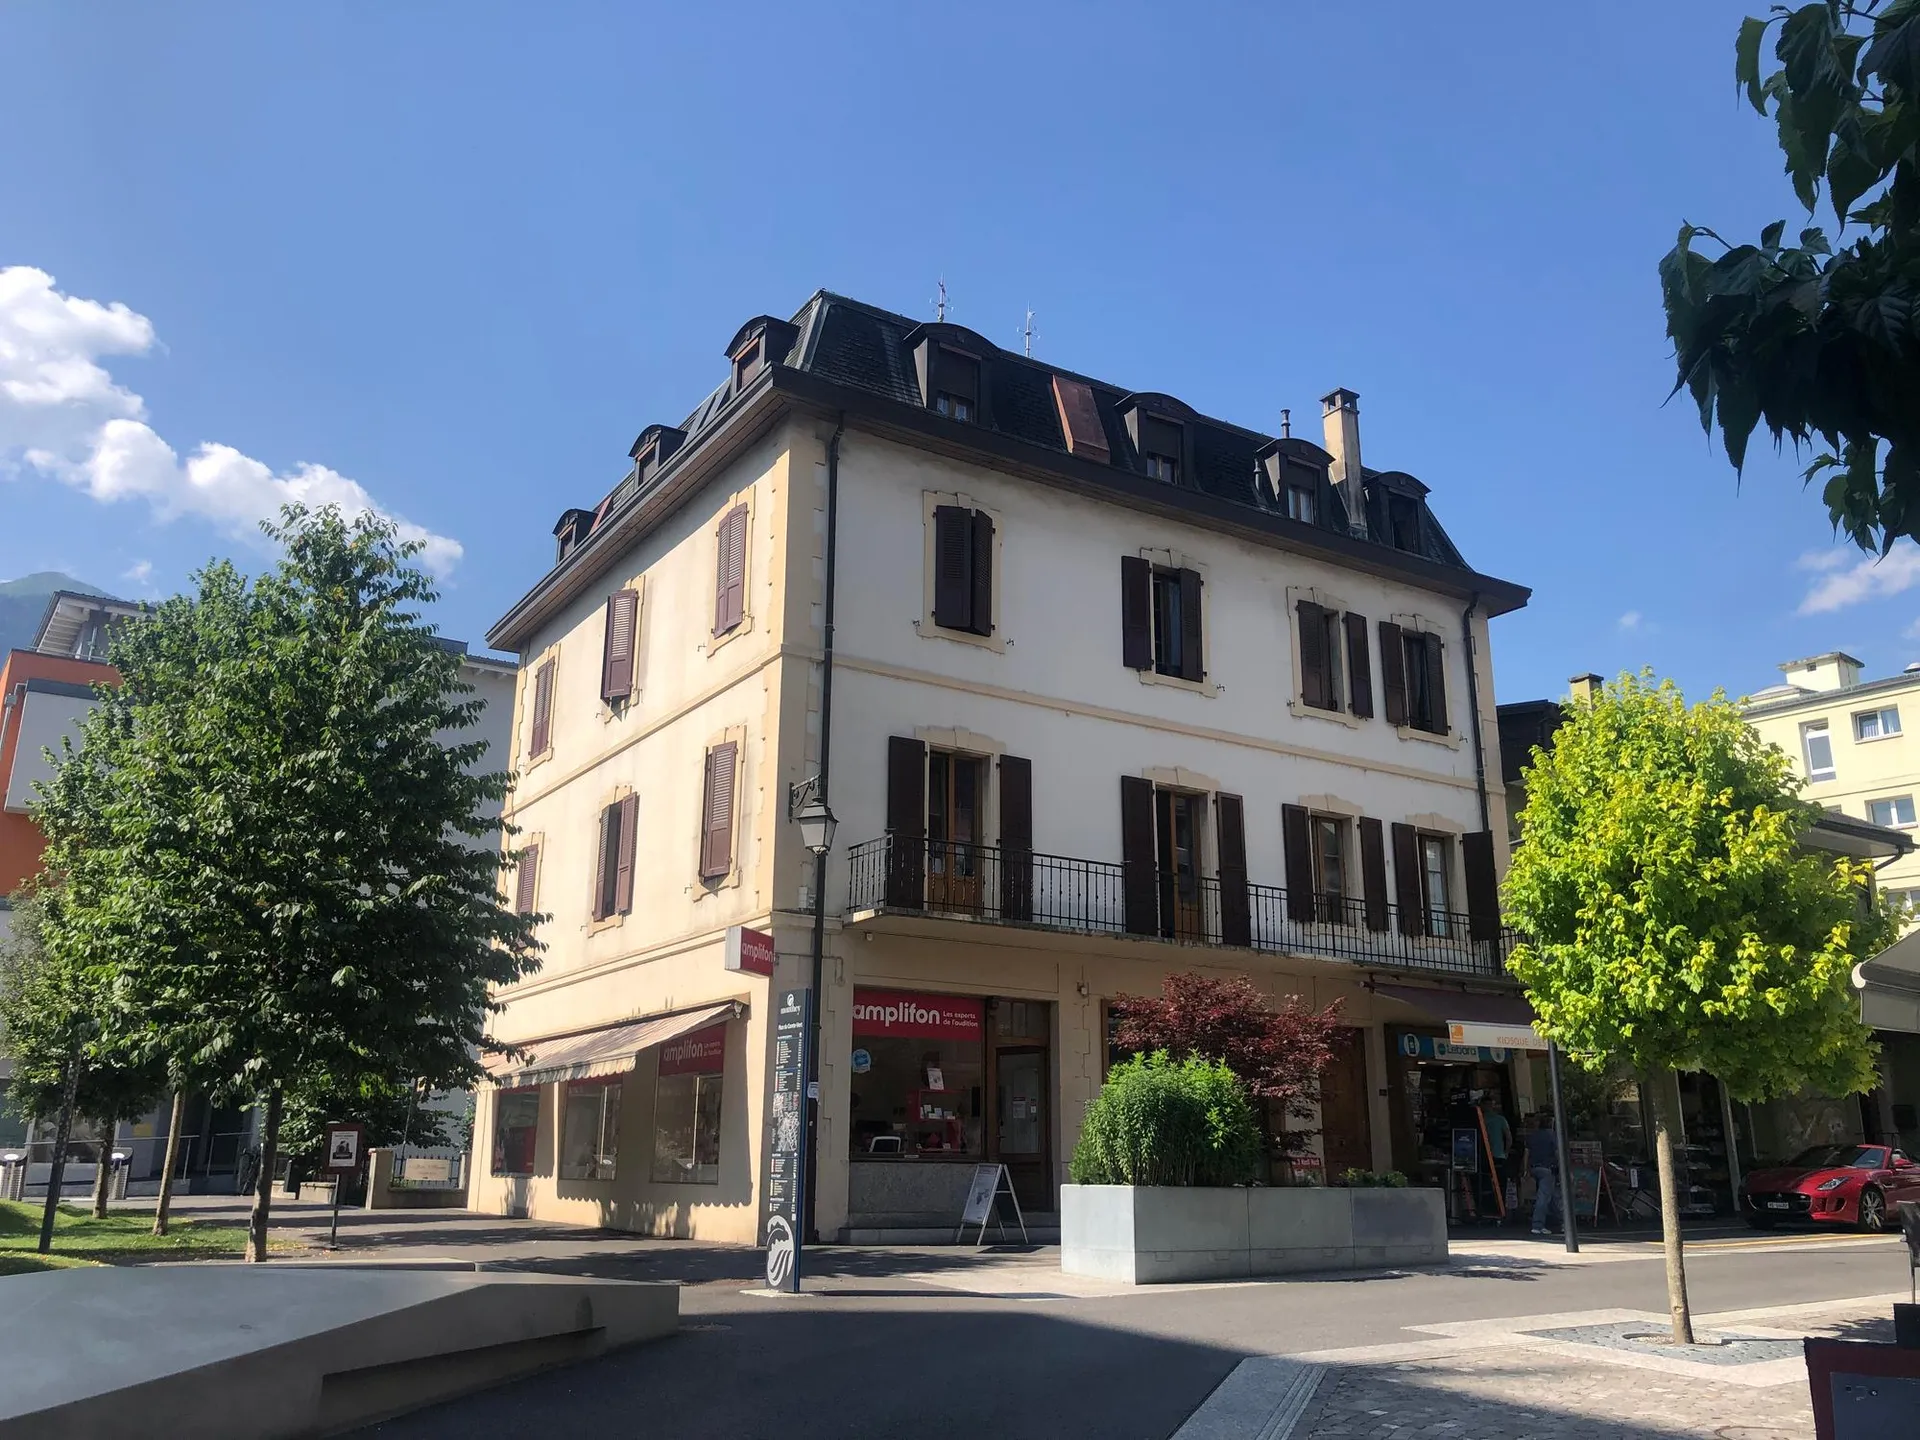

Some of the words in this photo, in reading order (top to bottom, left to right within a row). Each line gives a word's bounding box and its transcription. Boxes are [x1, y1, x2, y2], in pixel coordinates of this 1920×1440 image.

[742, 942, 774, 962] amplifon
[852, 1001, 940, 1027] amplifon
[663, 1036, 704, 1066] amplifon
[1496, 1036, 1529, 1046] KIOSQUE
